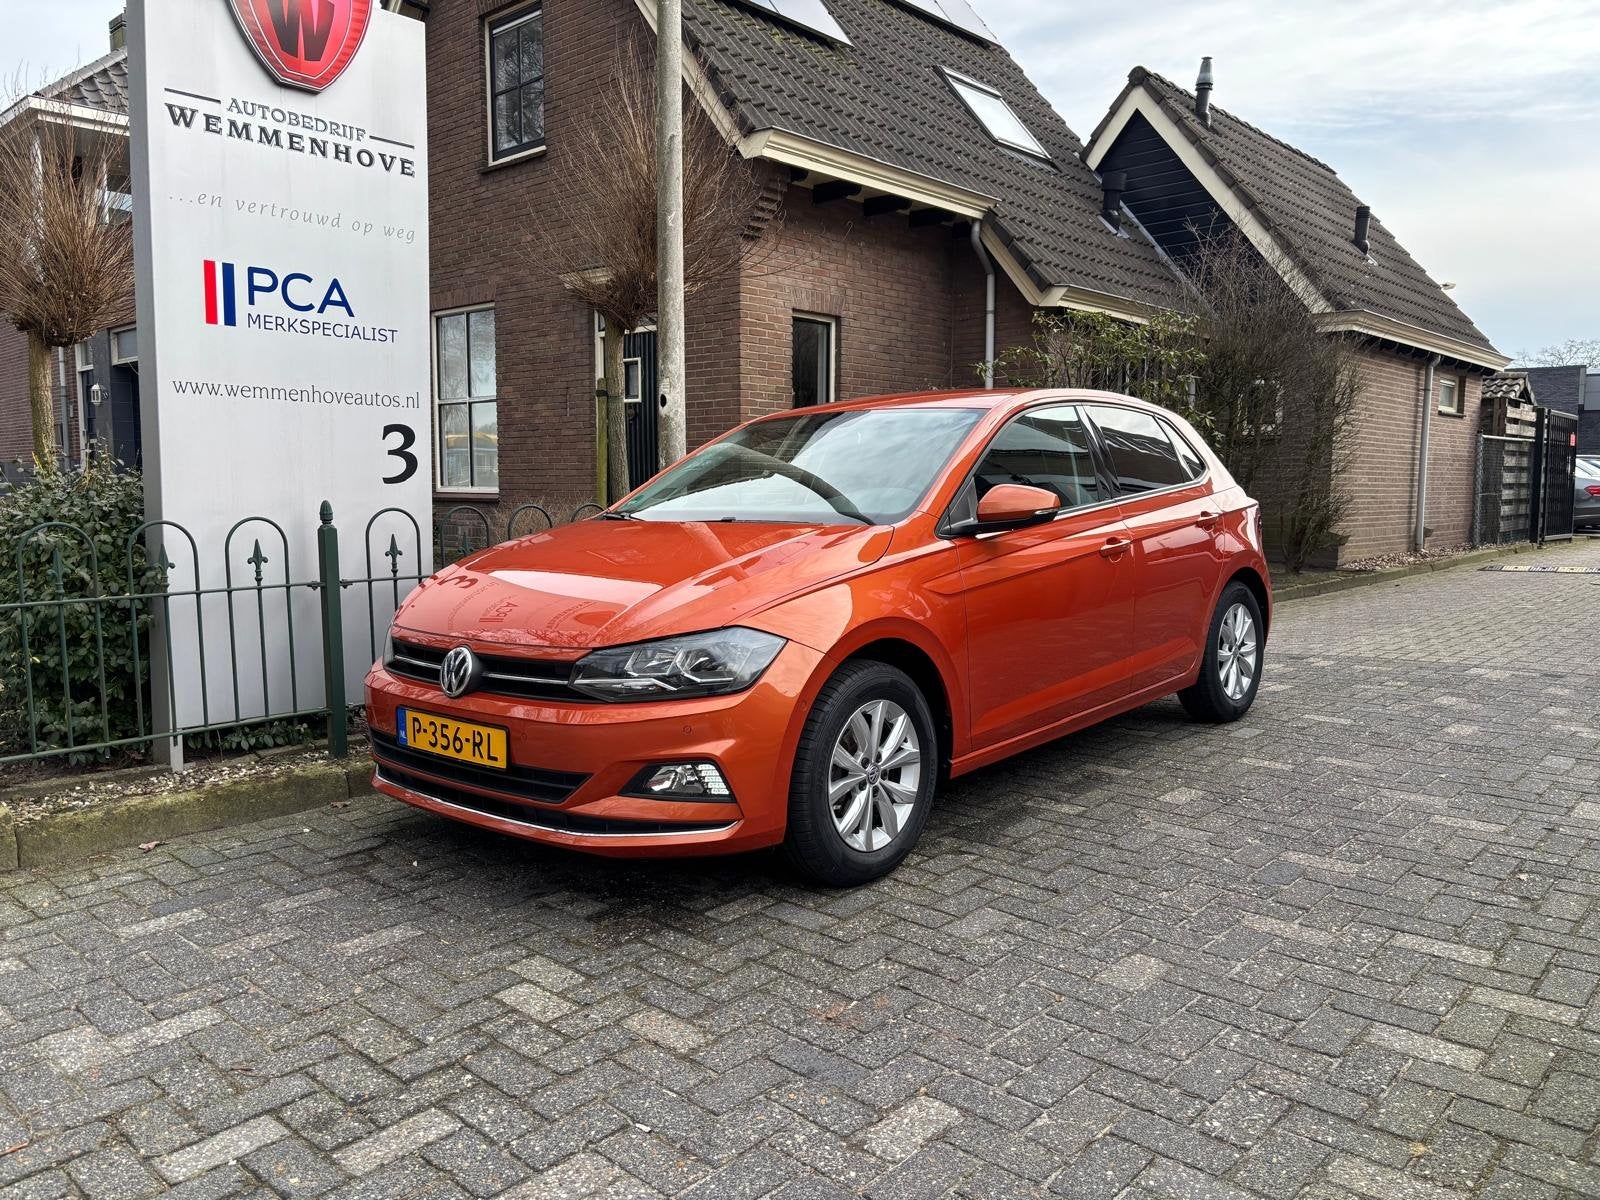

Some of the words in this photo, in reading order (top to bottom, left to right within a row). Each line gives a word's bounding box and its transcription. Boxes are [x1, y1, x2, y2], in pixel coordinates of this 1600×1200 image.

[164, 102, 416, 178] WEMMENHOVE
[227, 97, 366, 142] AUTOBEDRIJF
[236, 198, 342, 229] vertrouwd
[351, 219, 373, 237] op
[383, 225, 415, 244] weg
[247, 266, 355, 318] PCA
[247, 313, 399, 343] MERKSPECIALIST
[172, 379, 420, 409] www.wemmenhoveautos.nl
[381, 423, 419, 485] 3
[412, 716, 498, 762] P-356-RL
